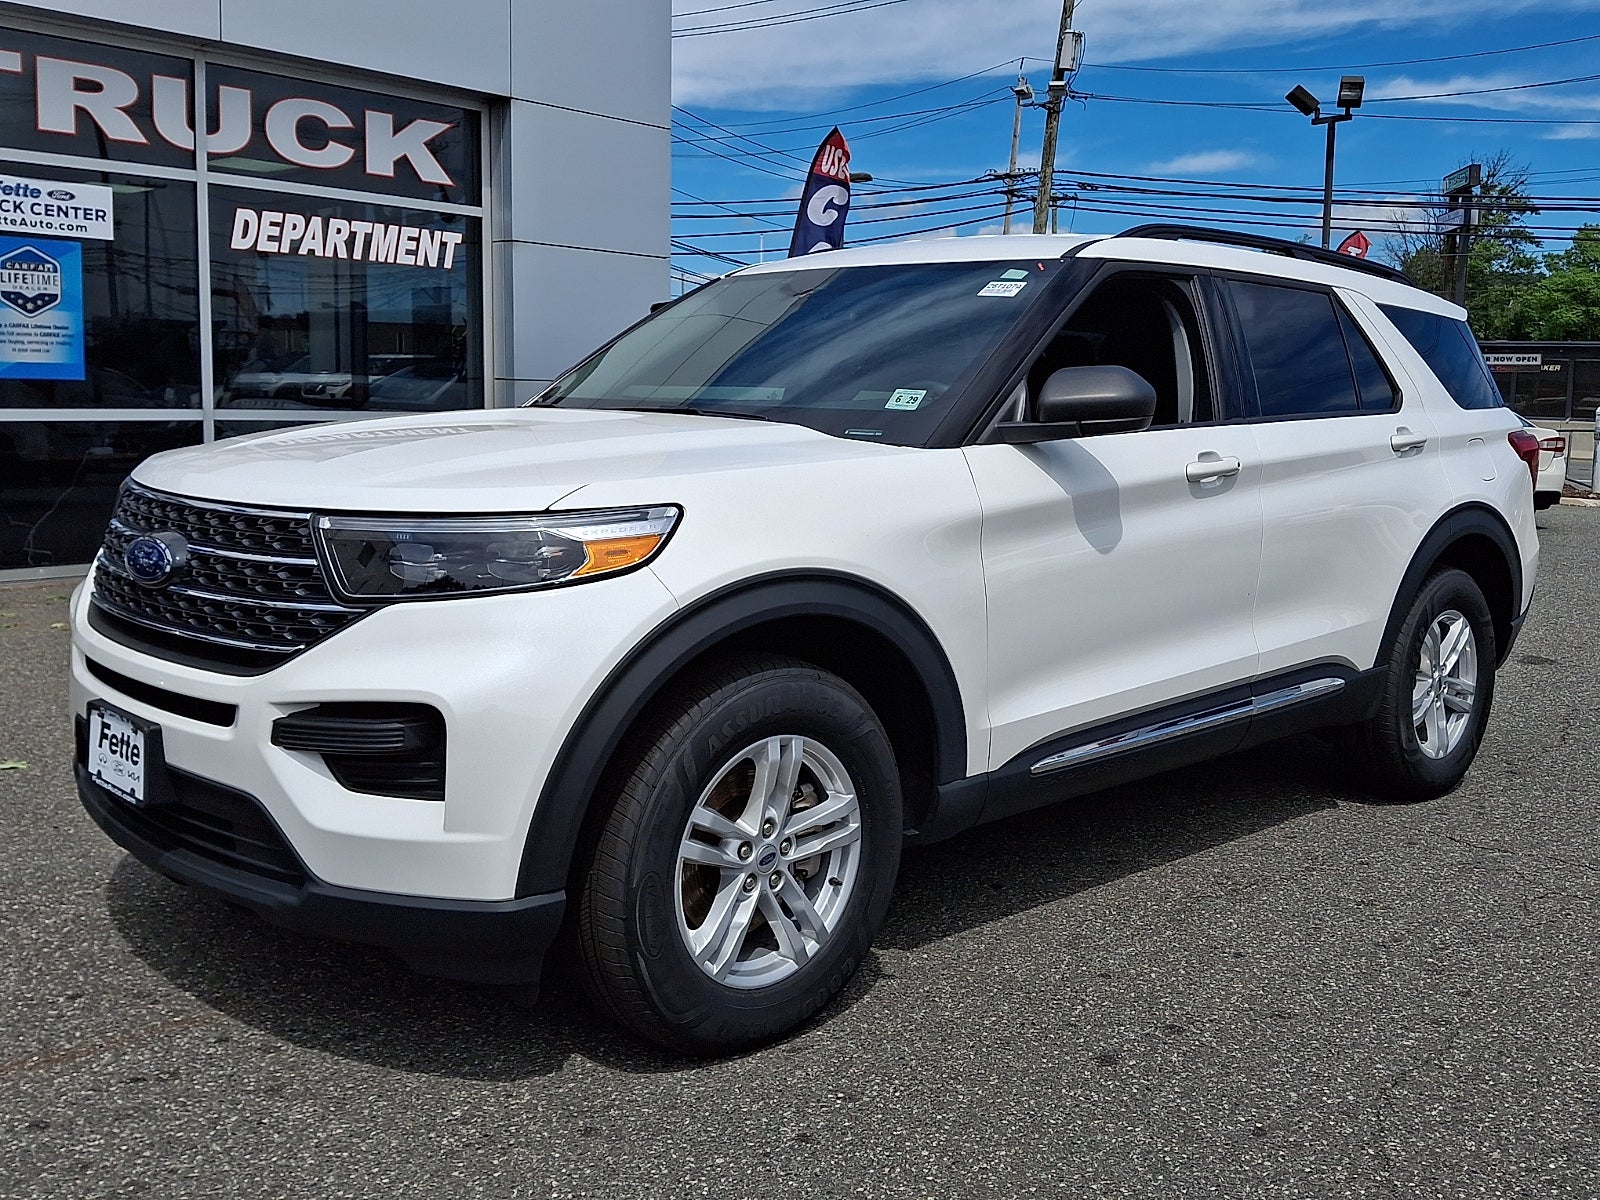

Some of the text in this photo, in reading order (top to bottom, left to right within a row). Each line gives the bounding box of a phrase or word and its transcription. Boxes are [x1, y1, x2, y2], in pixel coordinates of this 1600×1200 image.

[0, 50, 456, 187] RUCK
[821, 144, 850, 180] USE
[0, 180, 42, 199] ette
[30, 202, 107, 222] CENTER
[230, 207, 463, 270] DEPARTMENT
[6, 261, 53, 272] CARFAX
[0, 271, 59, 287] LIFETIME
[895, 394, 919, 405] 6 29
[582, 524, 657, 536] EXPLORR
[97, 720, 141, 767] Fette
